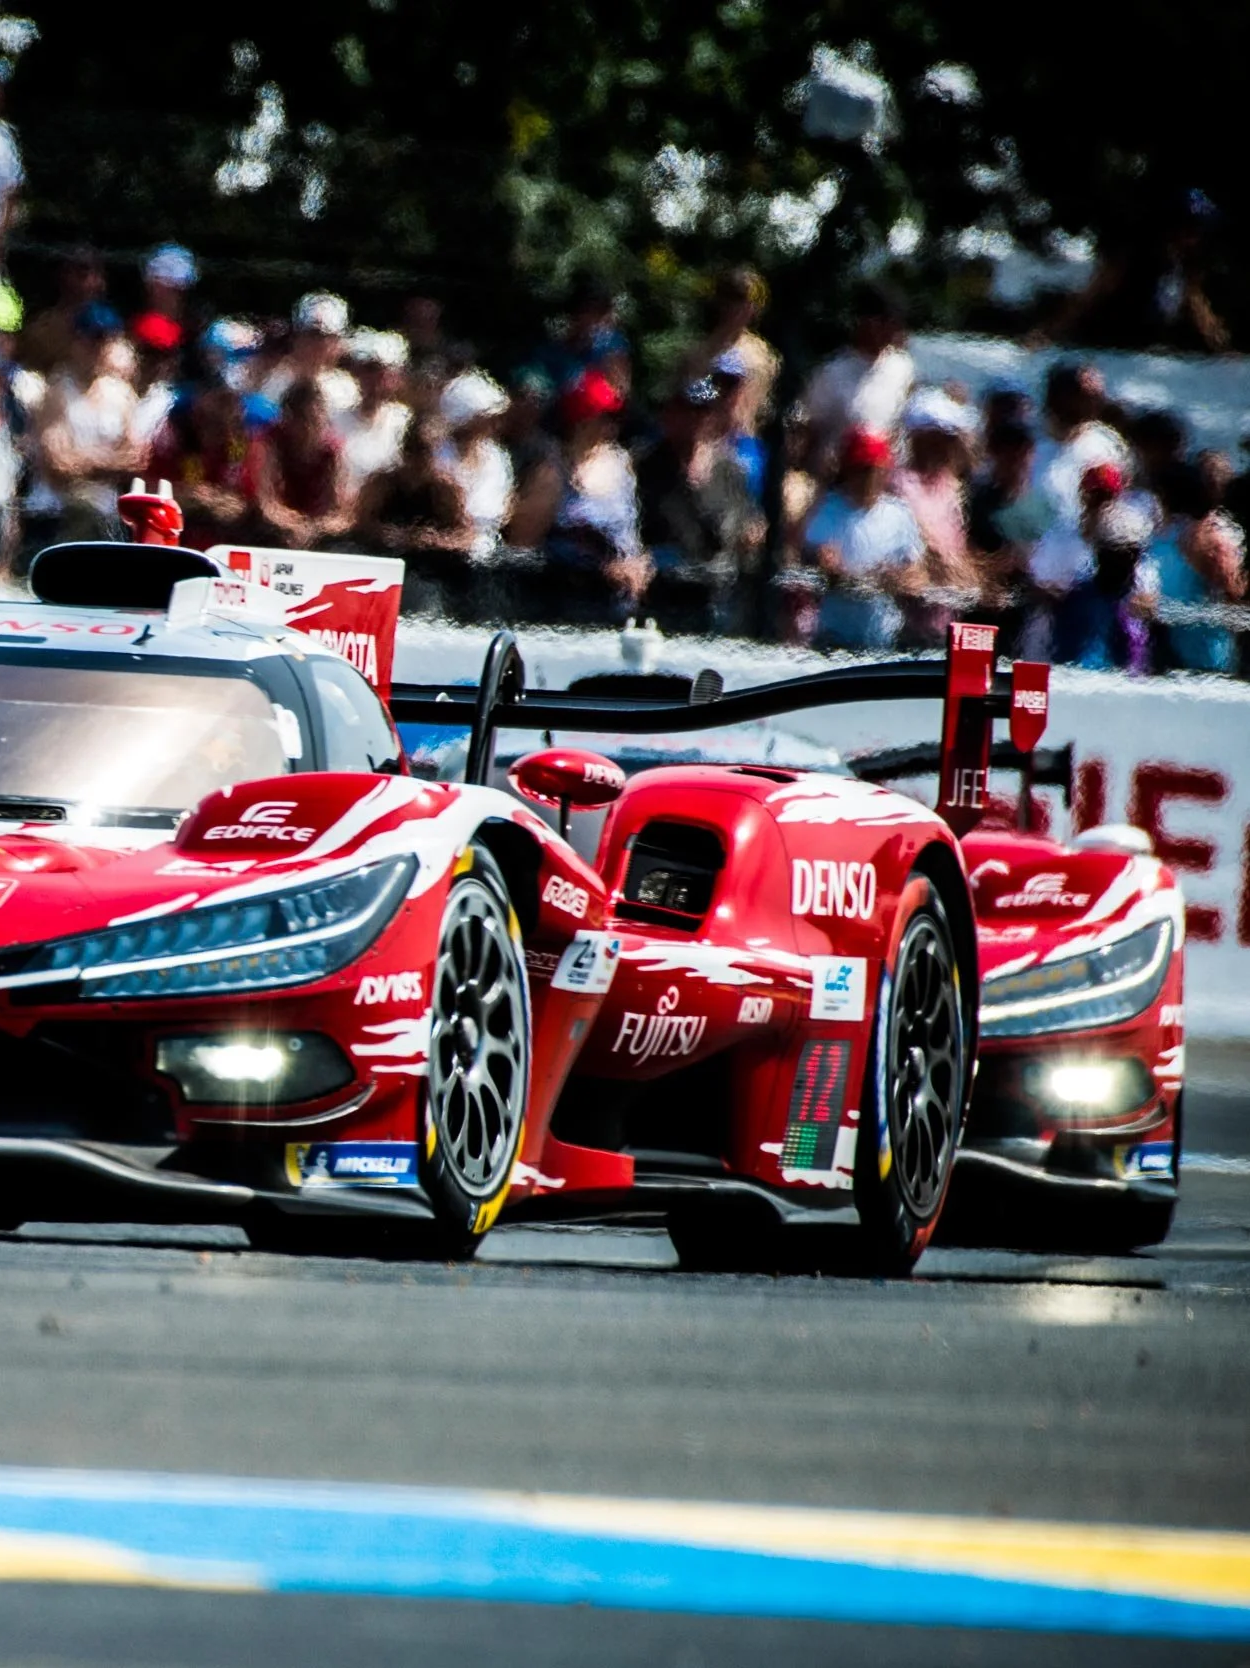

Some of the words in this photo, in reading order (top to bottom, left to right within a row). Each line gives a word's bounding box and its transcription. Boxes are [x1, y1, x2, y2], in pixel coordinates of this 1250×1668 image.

[946, 768, 986, 809] JFE
[203, 825, 317, 843] EDIFICE
[791, 858, 877, 920] DENSO
[995, 890, 1091, 908] EDIFICE
[736, 996, 774, 1024] AISIN
[611, 1011, 708, 1067] FUJITSU
[333, 1156, 412, 1174] MICHELIN
